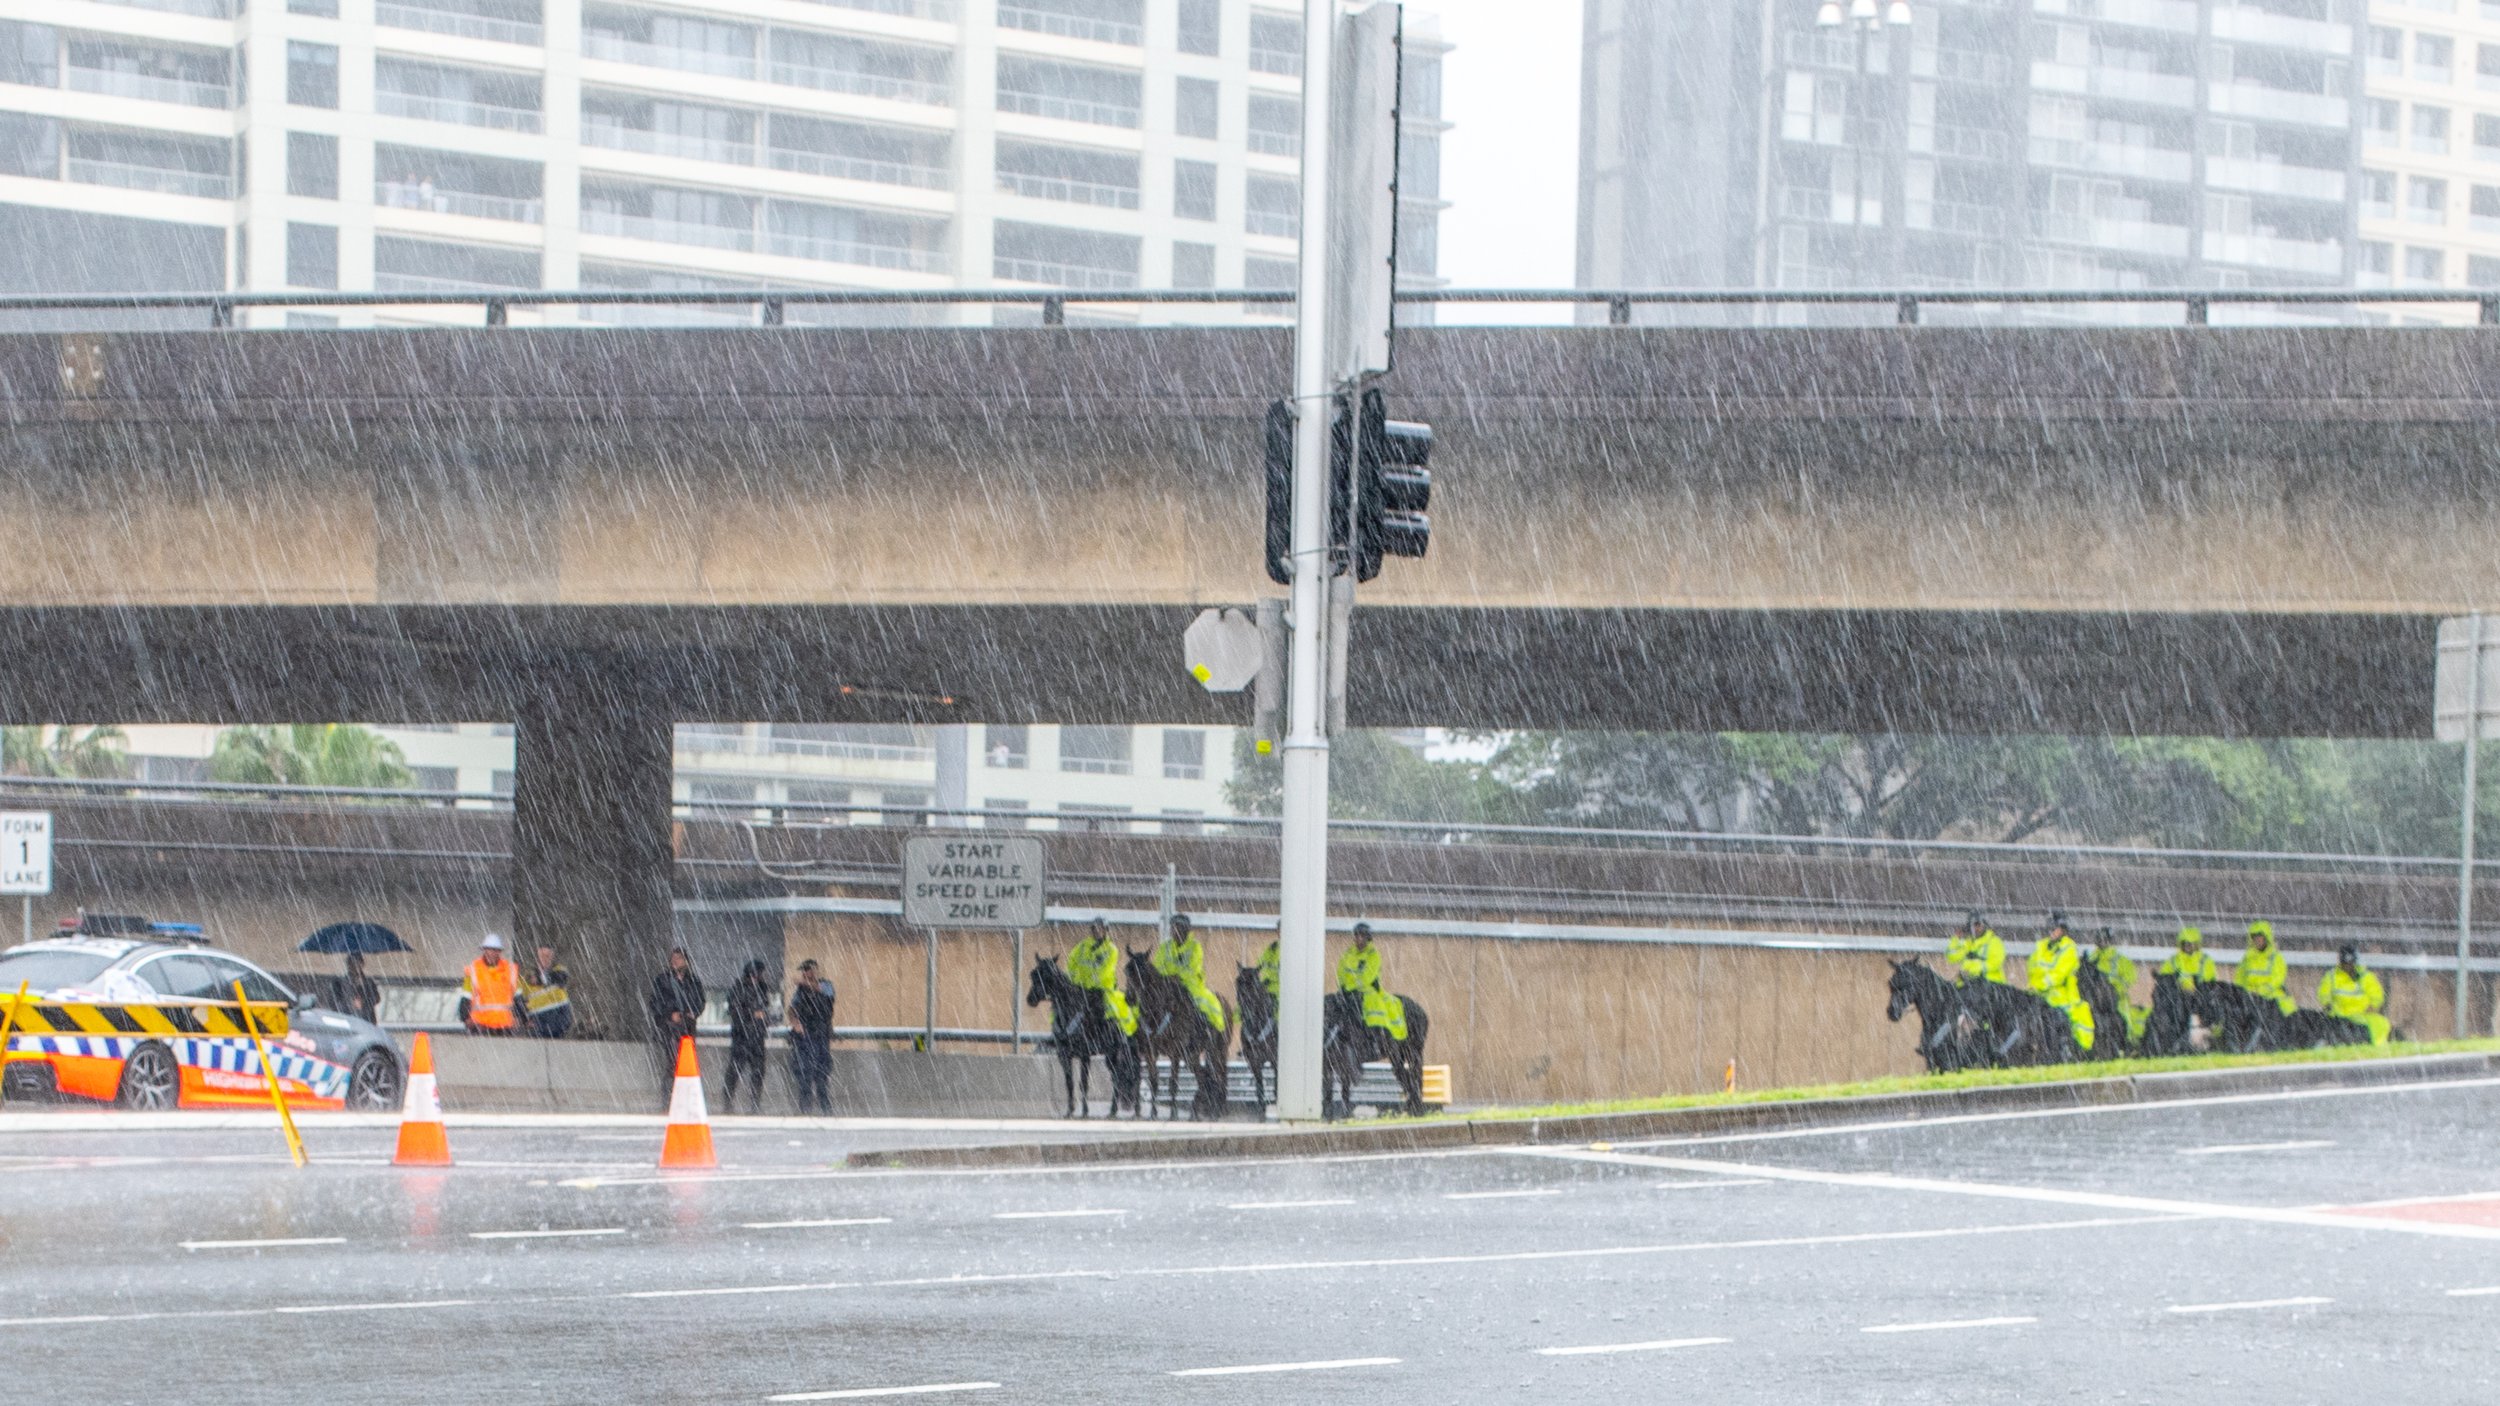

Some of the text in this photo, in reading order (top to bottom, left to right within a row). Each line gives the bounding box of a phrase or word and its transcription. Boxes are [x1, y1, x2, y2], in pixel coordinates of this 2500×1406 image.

[3, 819, 44, 833] FORM
[20, 840, 29, 865] 1
[944, 843, 1004, 859] START
[3, 870, 43, 885] LANE
[926, 864, 1022, 880] VARIABLE
[915, 882, 1032, 899] SPEED LIMIT
[948, 903, 999, 919] ZONE
